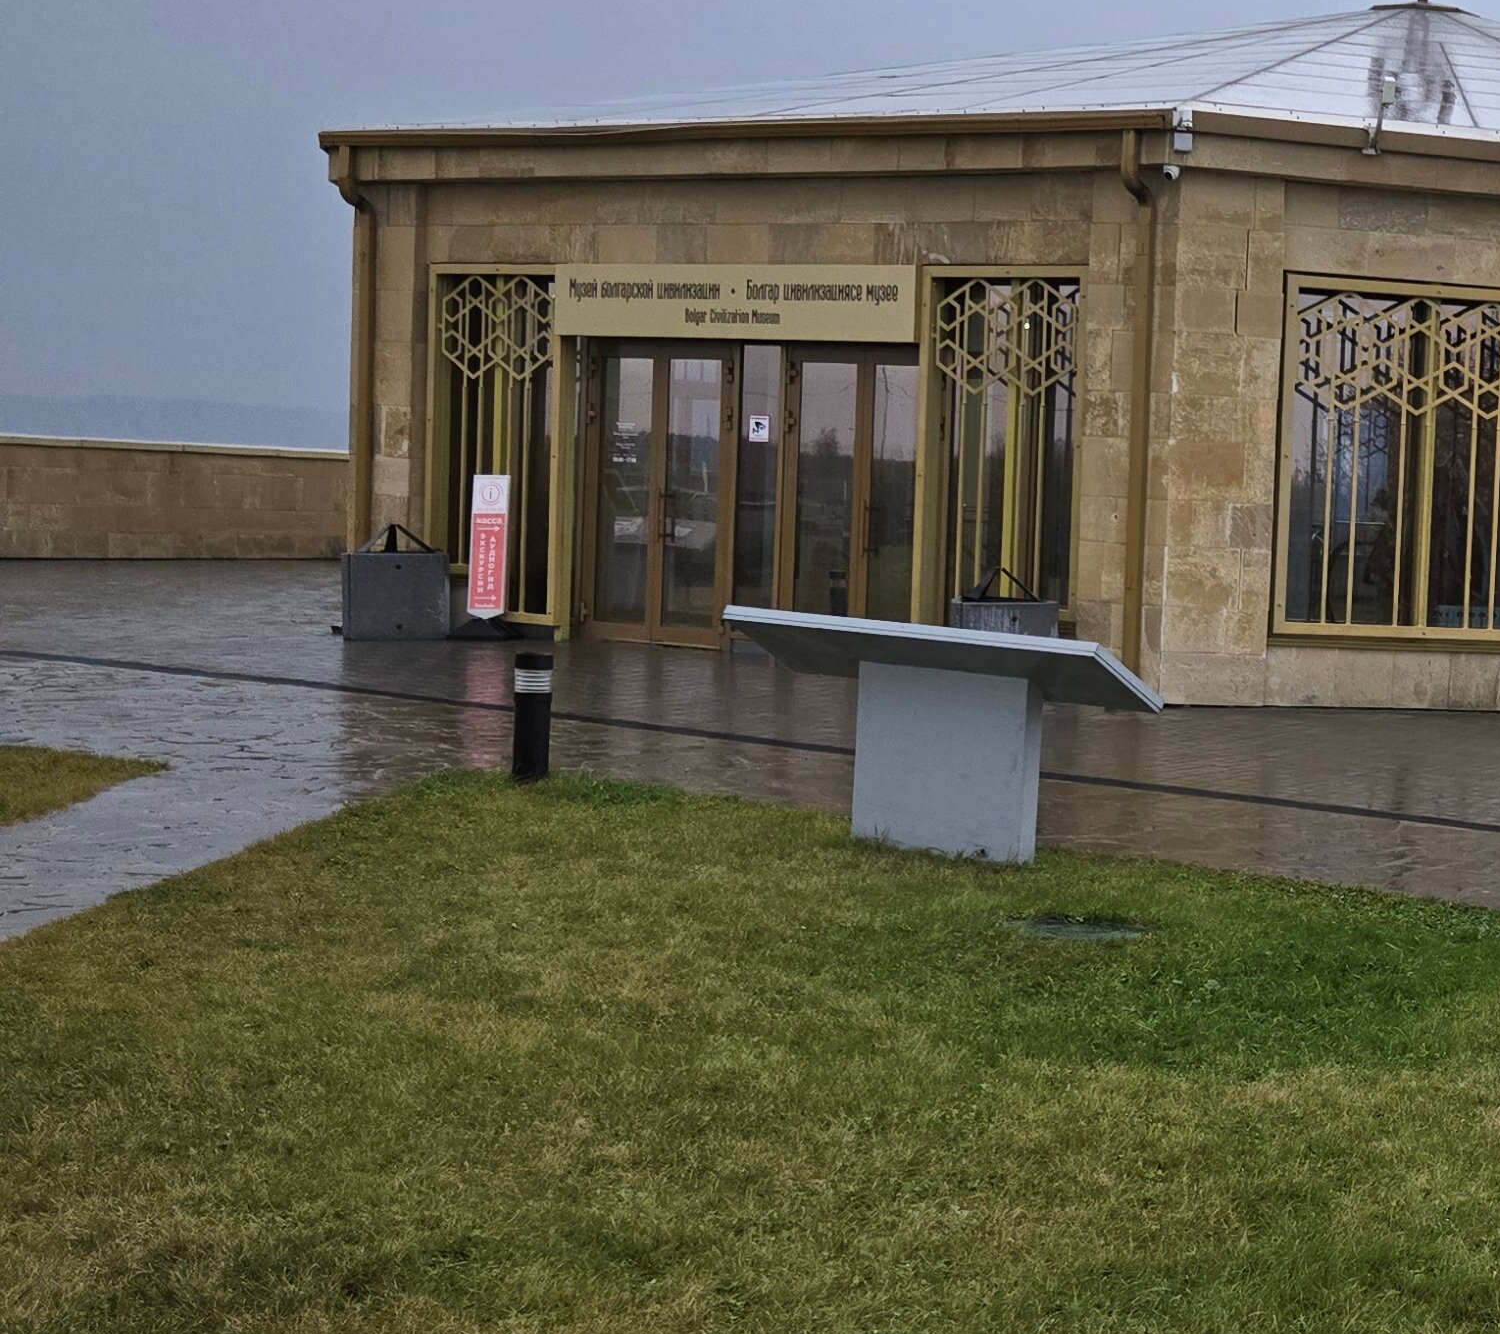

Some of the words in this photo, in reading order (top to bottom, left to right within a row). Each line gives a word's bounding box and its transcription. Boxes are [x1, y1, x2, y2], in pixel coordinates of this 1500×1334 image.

[569, 278, 598, 303] Музей
[601, 278, 654, 303] болгарской
[656, 281, 721, 300] цивилизации
[746, 279, 779, 305] Болгар
[783, 282, 862, 302] цивилизациясе
[866, 283, 899, 306] музее
[684, 307, 707, 326] Bolgar
[709, 308, 750, 324] Civilization
[751, 308, 780, 324] Museum
[476, 533, 486, 594] ЭКСКУРСИИ
[487, 535, 497, 591] АУДИОГИД
